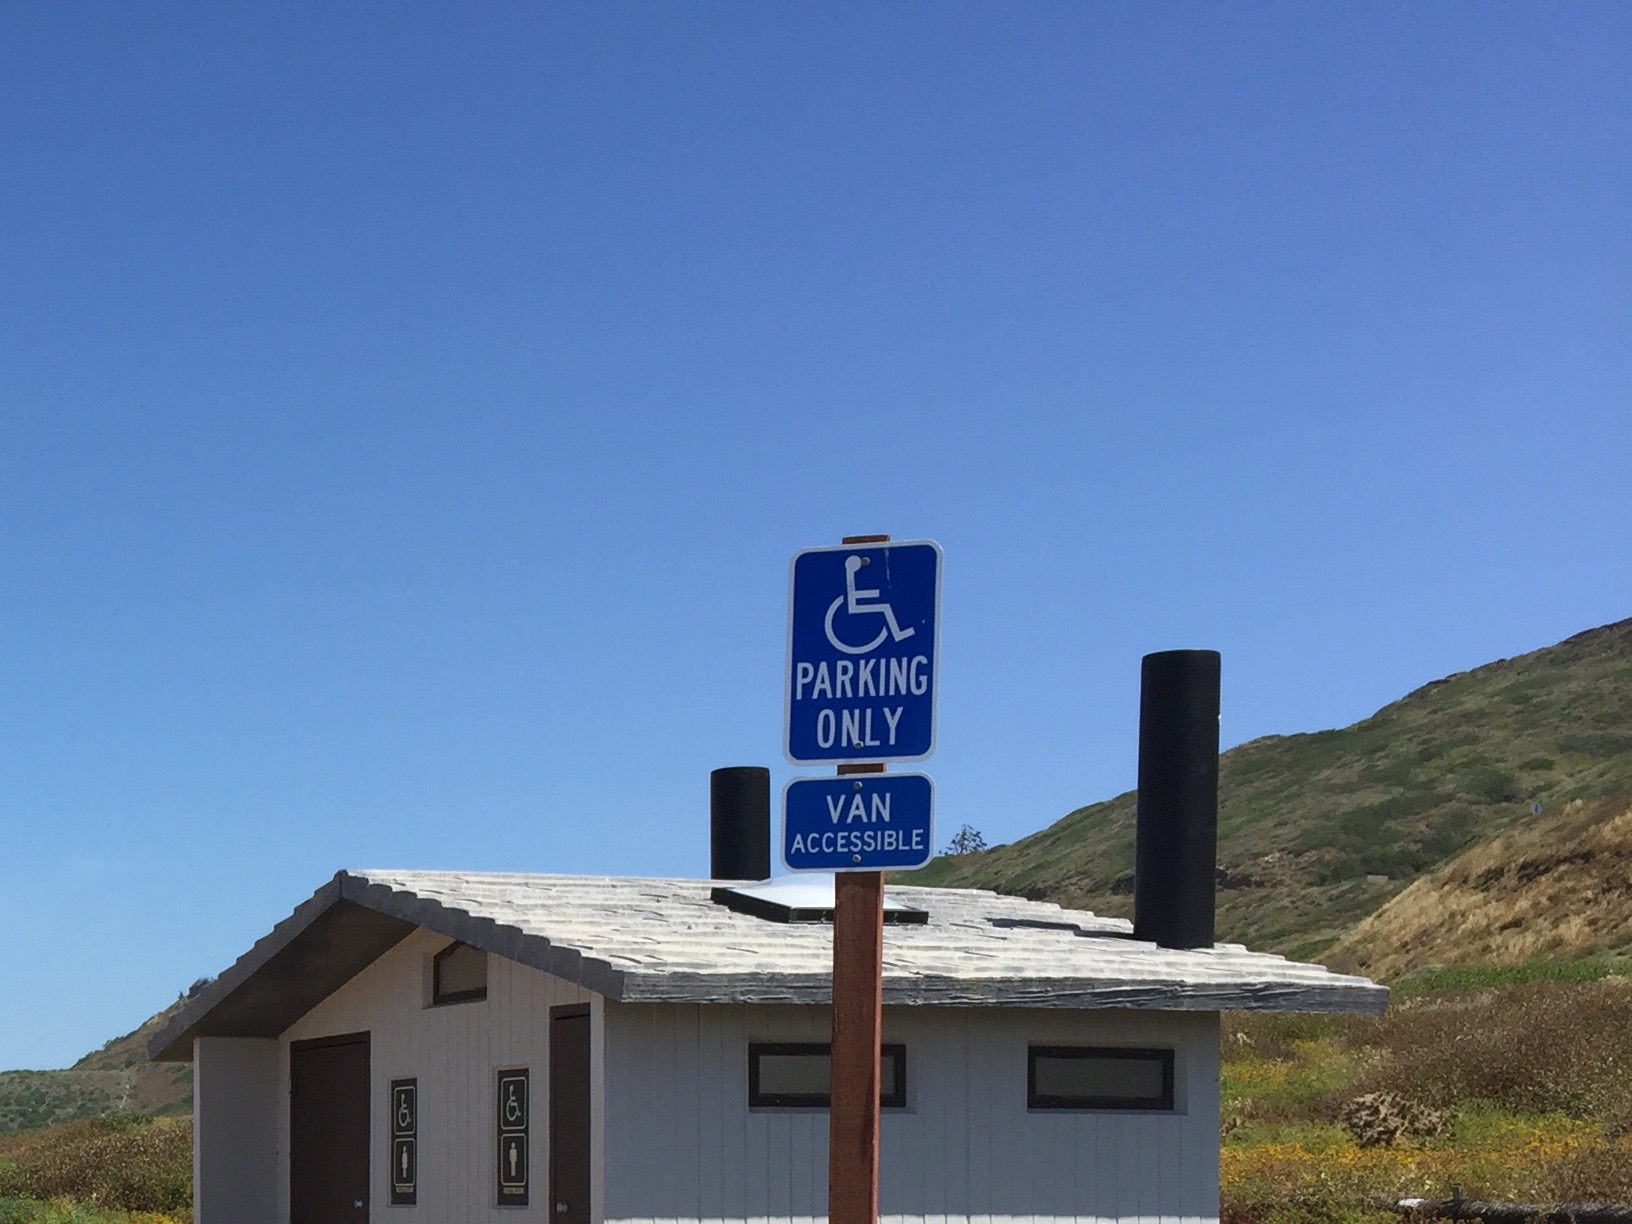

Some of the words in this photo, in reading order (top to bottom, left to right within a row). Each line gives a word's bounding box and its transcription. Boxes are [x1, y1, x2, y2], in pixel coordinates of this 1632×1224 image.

[795, 655, 928, 700] PARKING
[816, 706, 904, 749] ONLY
[826, 792, 891, 824] VAN
[790, 829, 924, 854] ACCESSIBLE
